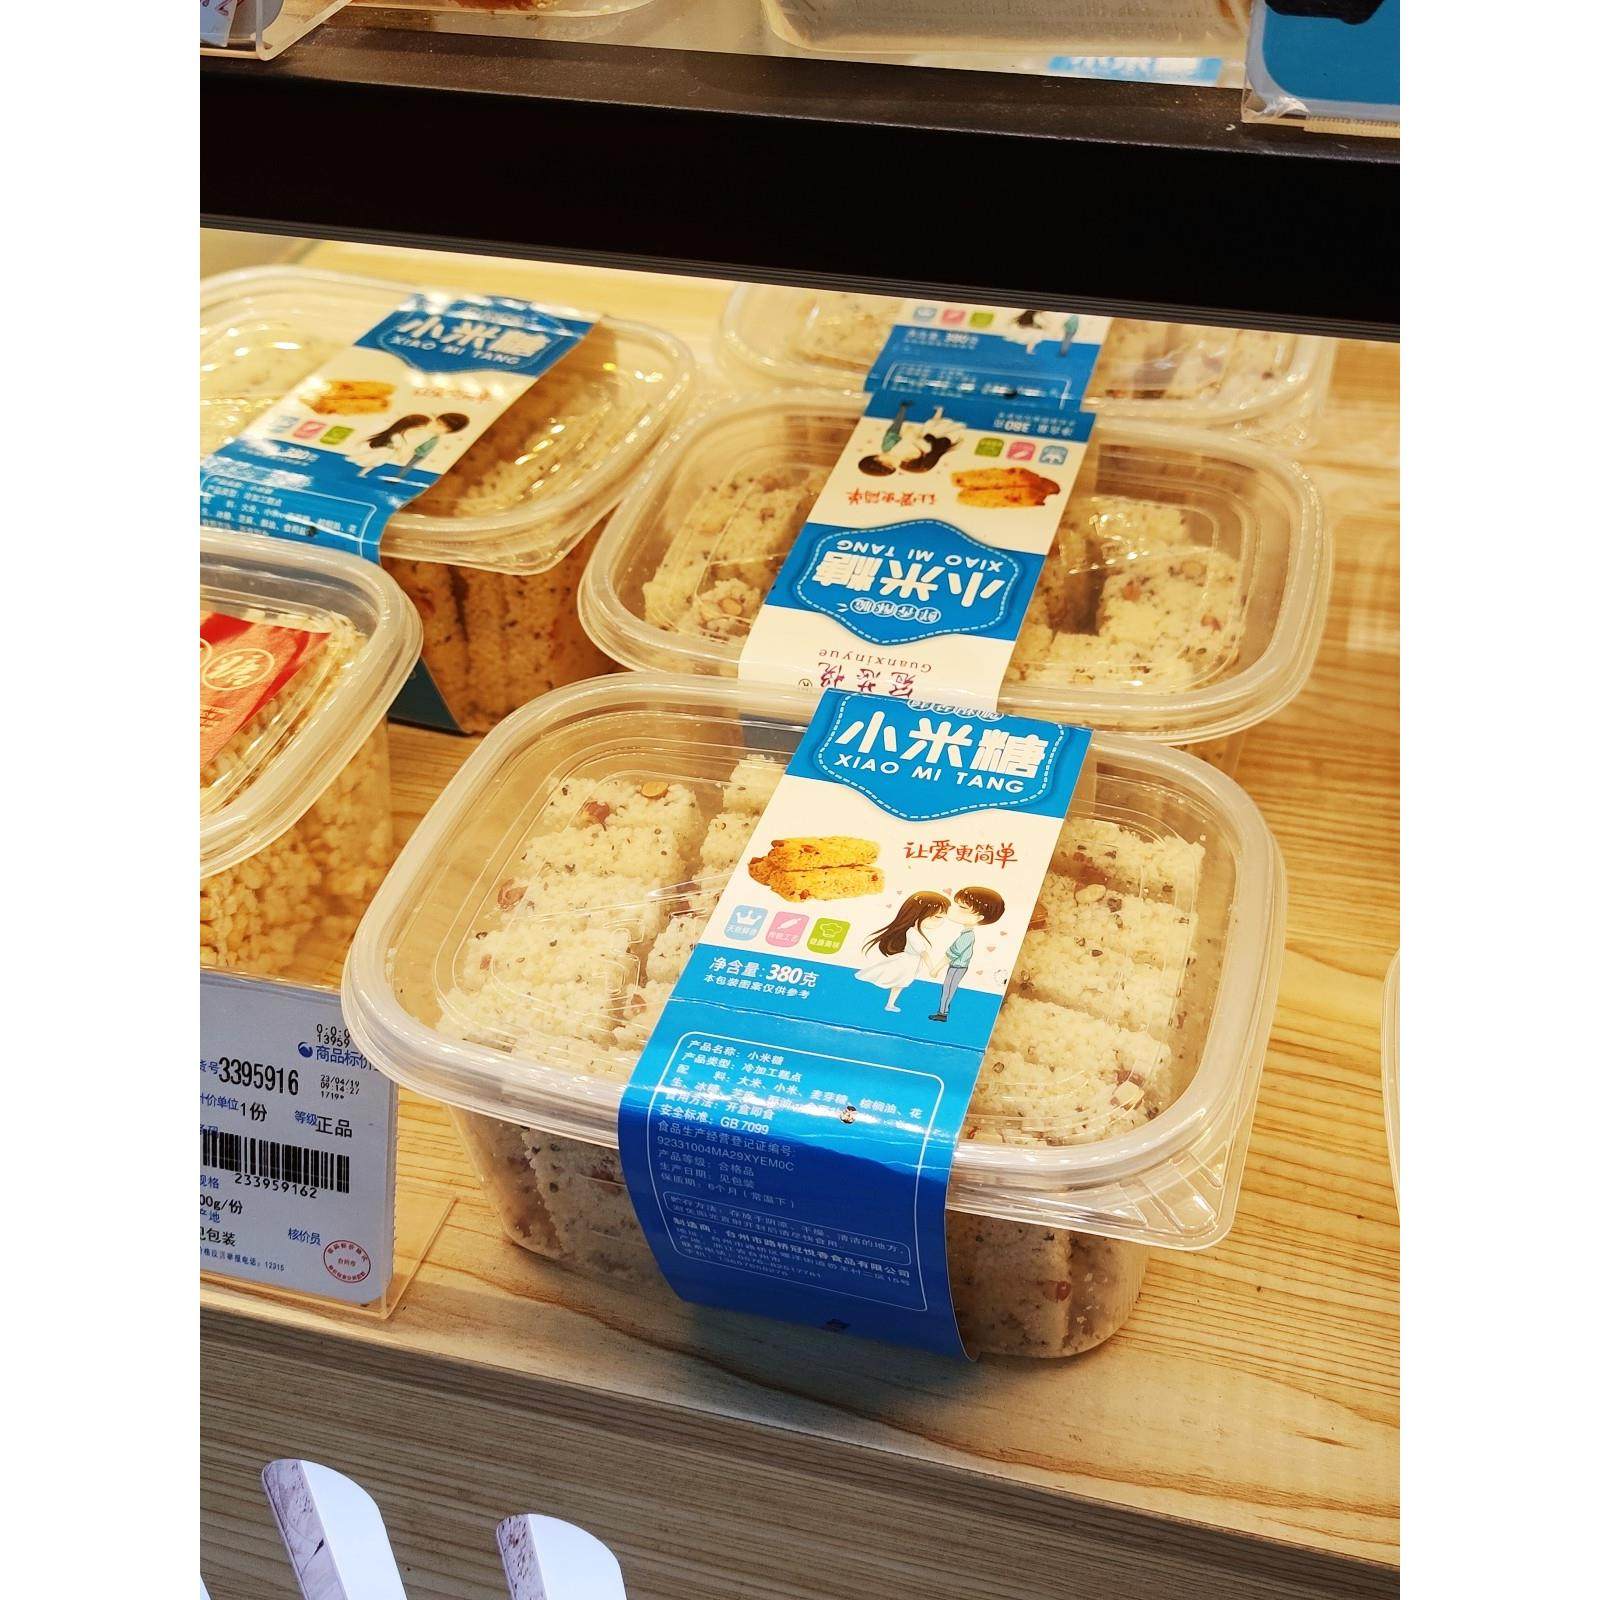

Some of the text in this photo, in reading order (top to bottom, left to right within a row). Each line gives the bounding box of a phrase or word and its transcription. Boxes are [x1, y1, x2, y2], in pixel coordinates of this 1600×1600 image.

[388, 334, 522, 367] XIAO MI TANG
[835, 539, 1005, 573] XIAO MI TANG
[811, 550, 1007, 608] 小米糖
[817, 649, 932, 674] Guanxinyue
[835, 710, 1049, 779] 小米糖
[833, 753, 1025, 794] XIAO MI TANG
[903, 840, 1018, 870] 让爱更简单
[703, 973, 810, 1000] 本包装图案仅供参考
[316, 1033, 350, 1049] 13959
[315, 1045, 380, 1072] 商品标价
[747, 1051, 784, 1065] 小米糖
[218, 1056, 299, 1096] 3395916
[320, 1074, 360, 1087] 23/04/19
[743, 1063, 803, 1082] 冷加工糕点
[294, 1110, 353, 1138] 等级 正品
[720, 1116, 739, 1130] GB
[741, 1120, 770, 1135] 7099
[909, 1107, 923, 1119] 花
[718, 1161, 754, 1177] 合格品
[234, 1172, 318, 1199] 233959162
[288, 1227, 322, 1246] 核价员
